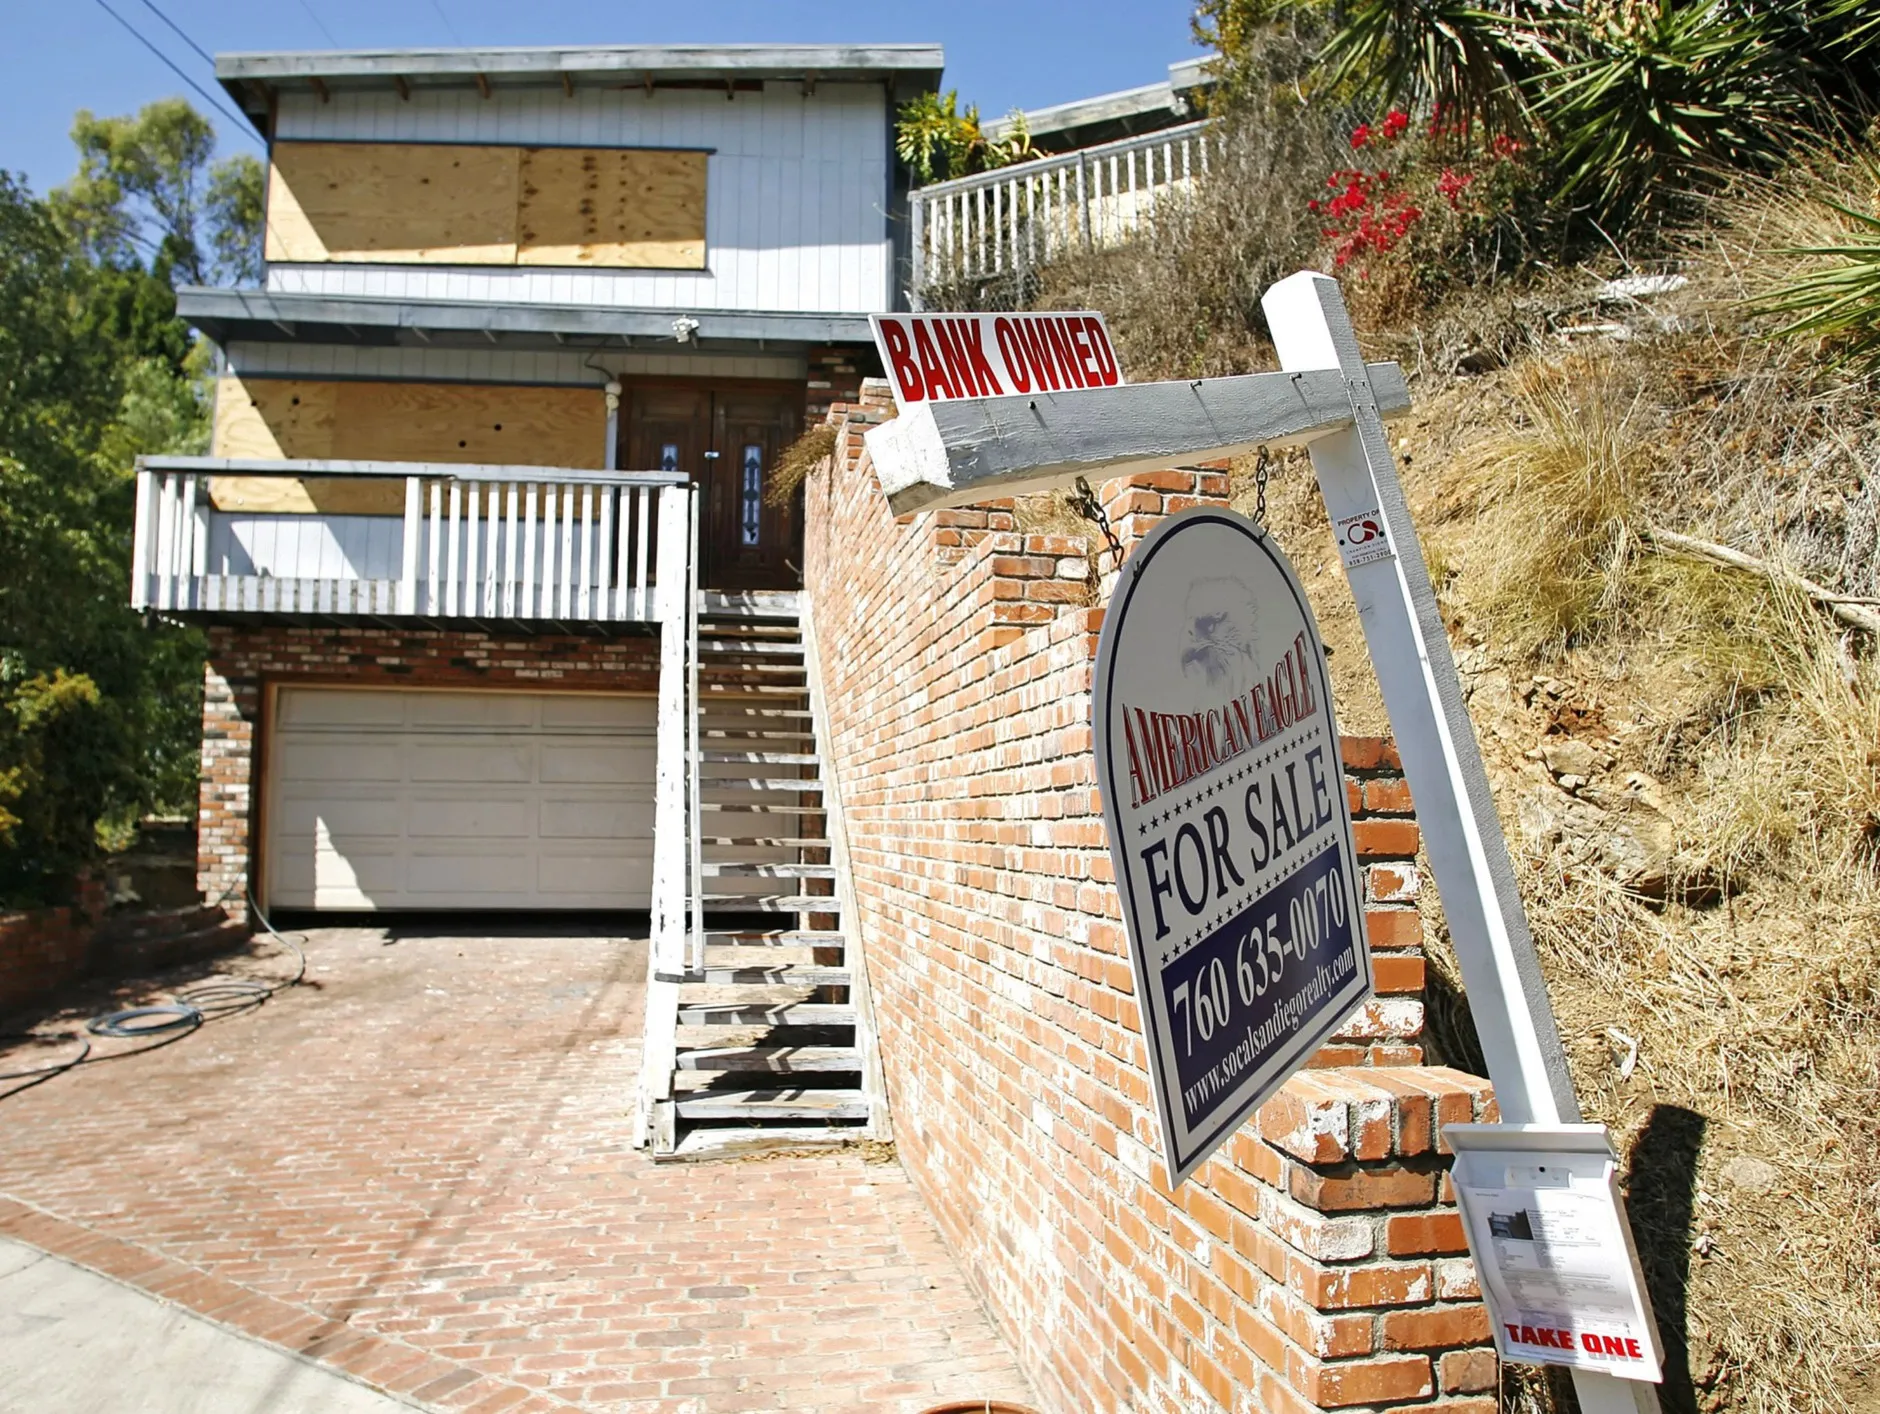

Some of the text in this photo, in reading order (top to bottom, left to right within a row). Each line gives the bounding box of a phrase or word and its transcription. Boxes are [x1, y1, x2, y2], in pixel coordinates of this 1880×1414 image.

[879, 317, 1118, 402] BANK OWNED
[1337, 512, 1370, 526] PROPERTY
[1122, 630, 1317, 809] AMERICAN EAGLE
[1140, 745, 1333, 941] FOR SALE
[1172, 867, 1344, 1057] 760 635-0070
[1184, 946, 1354, 1114] www.socalsandiegorealty.com
[1504, 1323, 1576, 1350] TAKE
[1580, 1333, 1643, 1359] ONE
